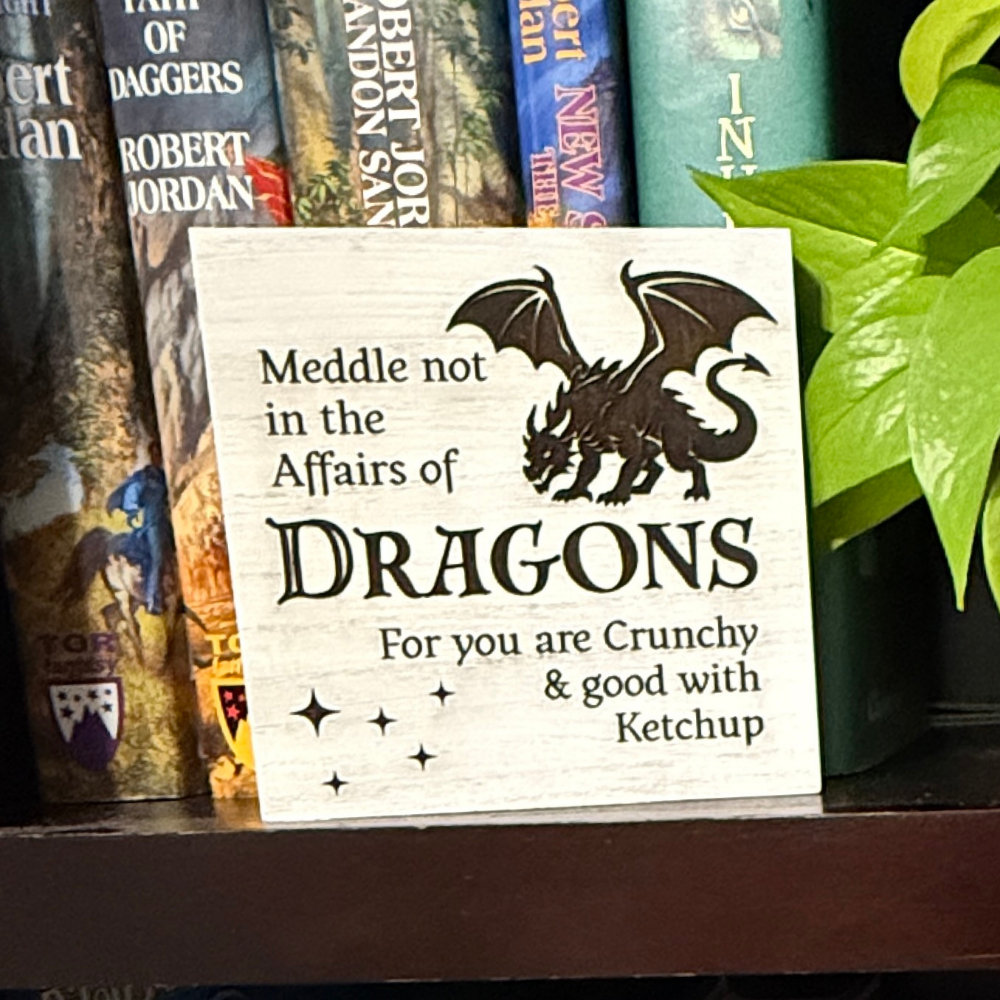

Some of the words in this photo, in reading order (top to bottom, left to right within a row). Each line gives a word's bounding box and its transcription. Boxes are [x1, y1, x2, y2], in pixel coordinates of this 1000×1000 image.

[143, 20, 187, 54] OF
[108, 61, 243, 101] DAGGERS
[378, 0, 421, 129] BERT
[119, 132, 249, 174] ROBERT
[554, 83, 605, 201] NEW
[127, 176, 254, 215] JORDAN
[530, 146, 560, 222] THE
[258, 347, 408, 384] Meddle
[422, 352, 488, 382] not
[266, 402, 307, 435] in
[320, 399, 386, 435] the
[272, 450, 407, 496] Affairs
[420, 448, 460, 494] of
[265, 517, 759, 605] DRAGONS
[380, 627, 441, 660] For
[452, 632, 522, 667] you
[535, 630, 592, 653] are
[604, 616, 759, 656] Crunchy
[544, 669, 571, 700] &
[582, 664, 666, 708] good
[677, 661, 761, 694] with
[616, 709, 764, 746] Ketchup
